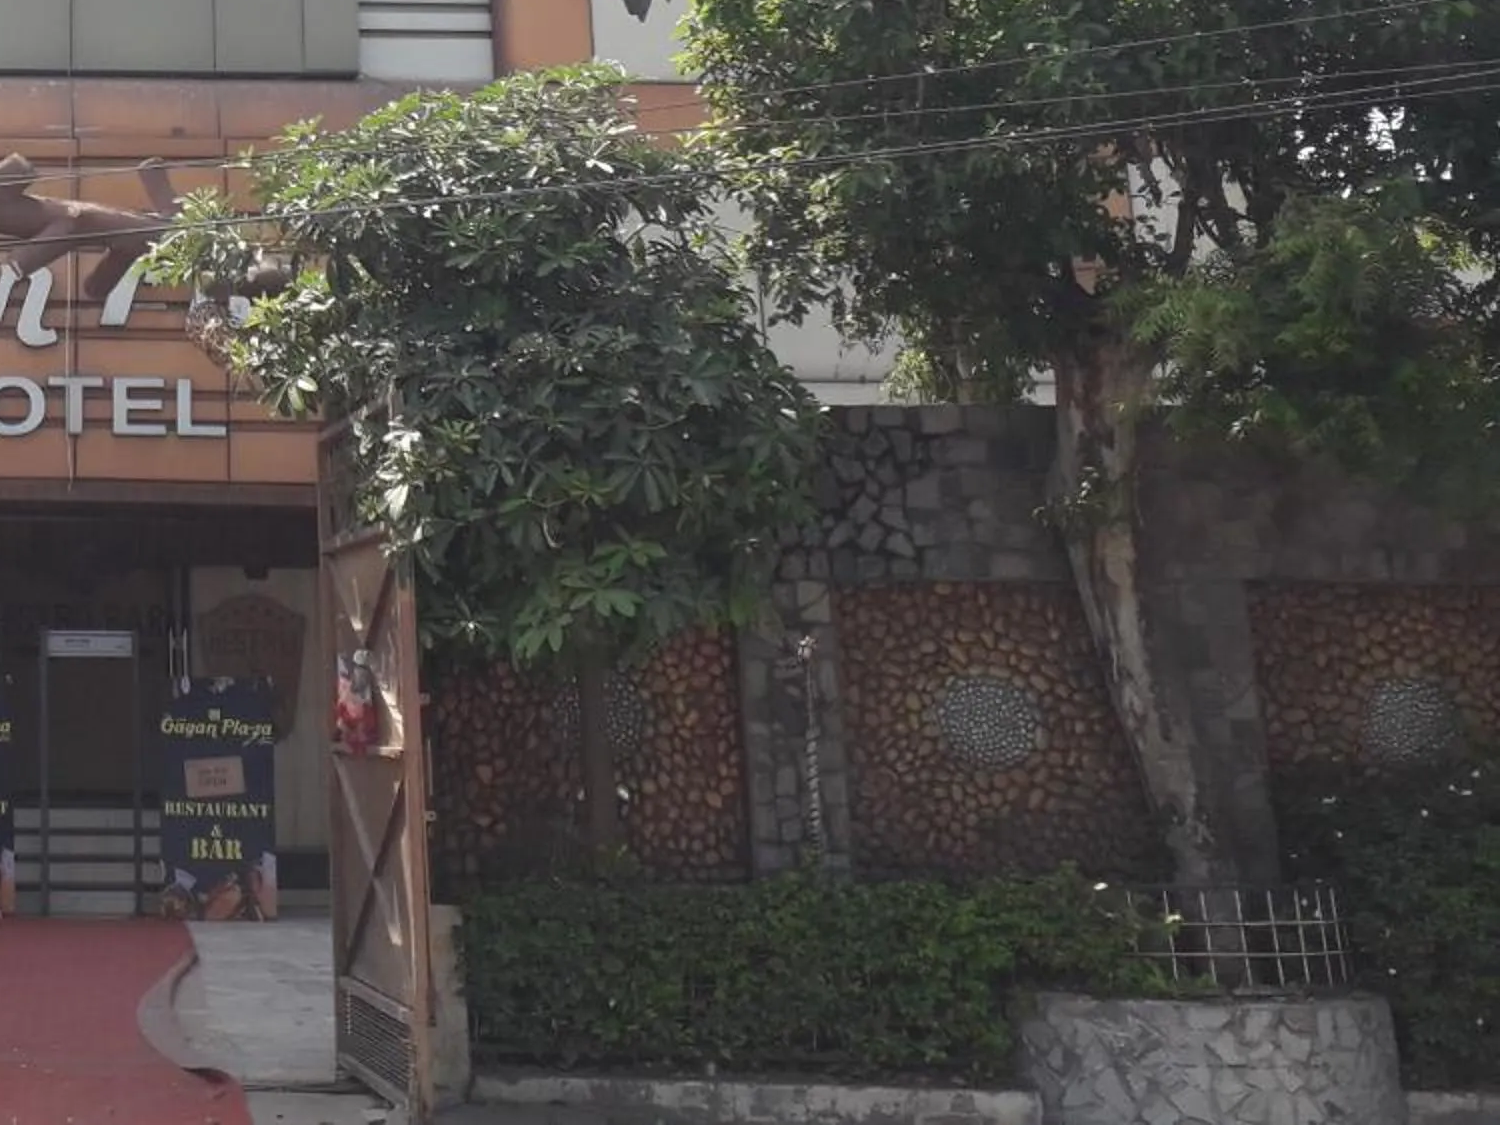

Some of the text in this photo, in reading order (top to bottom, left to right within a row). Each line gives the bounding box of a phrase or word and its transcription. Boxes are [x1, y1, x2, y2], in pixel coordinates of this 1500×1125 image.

[161, 717, 217, 738] Gagan
[165, 801, 269, 817] RESTAURANT
[191, 838, 243, 860] BAR
